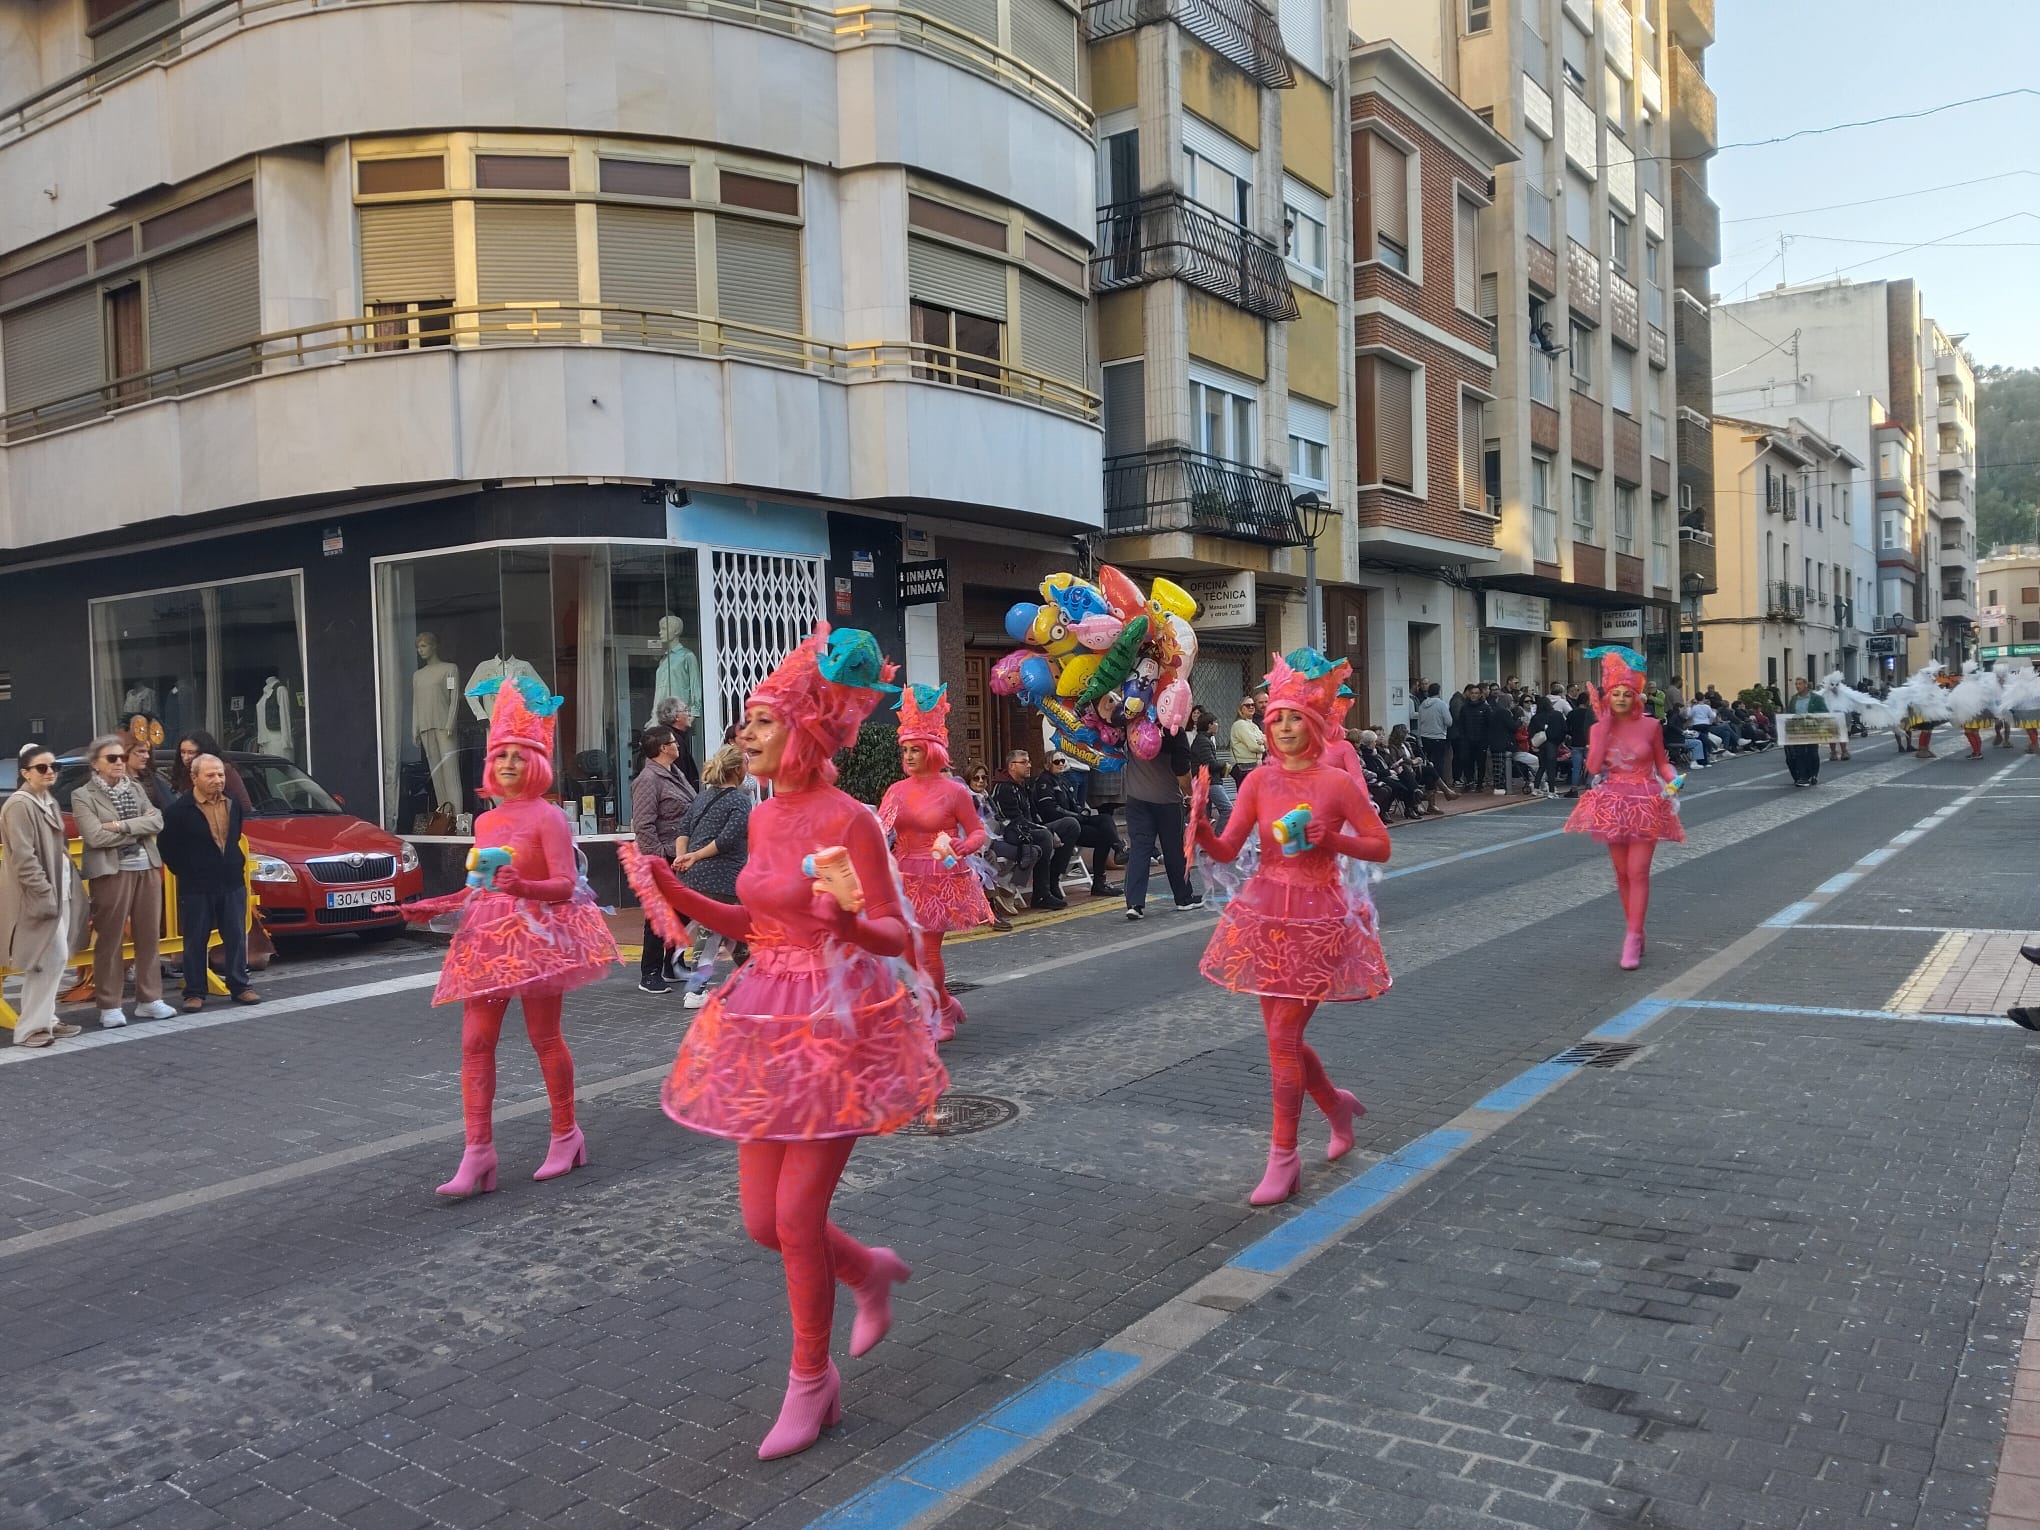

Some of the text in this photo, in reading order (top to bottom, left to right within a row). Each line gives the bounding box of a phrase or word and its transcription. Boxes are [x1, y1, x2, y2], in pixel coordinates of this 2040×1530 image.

[906, 567, 945, 583] INNAYA
[906, 581, 945, 596] INNAYA
[1190, 580, 1229, 592] OFICINA
[1208, 603, 1228, 611] Manuel
[1615, 620, 1638, 628] LLUNA
[337, 889, 392, 906] 3041 GNS
